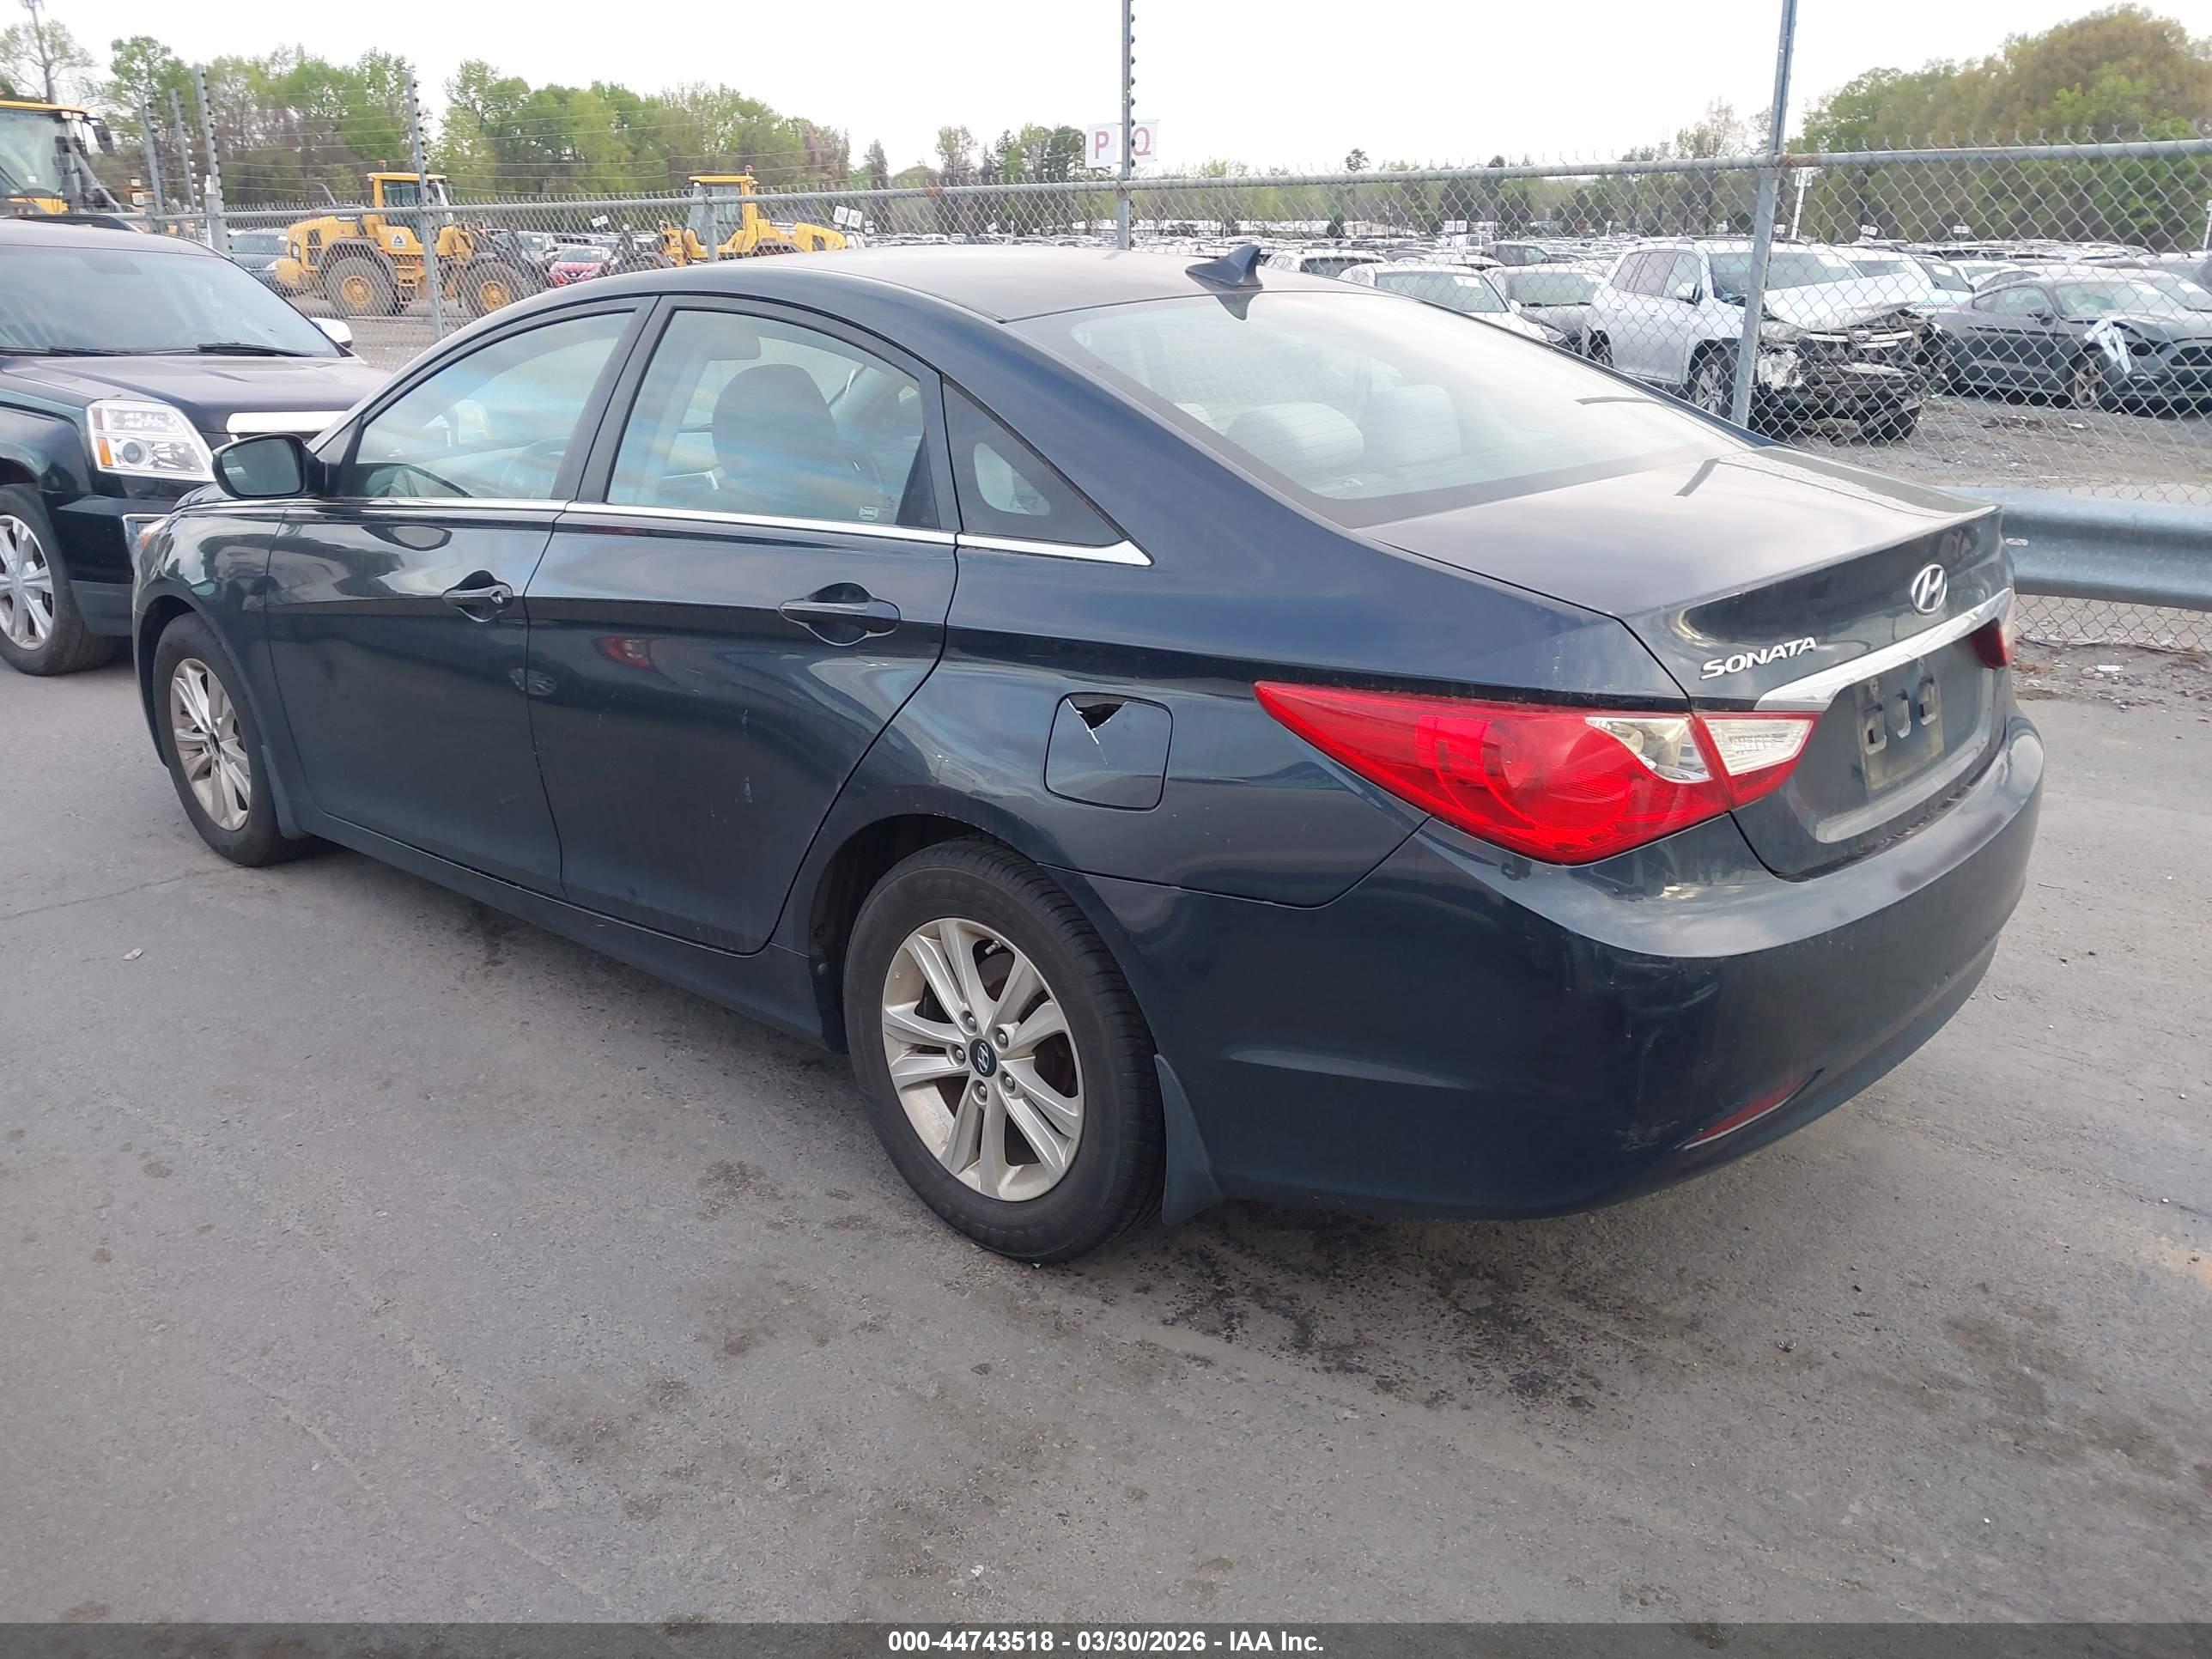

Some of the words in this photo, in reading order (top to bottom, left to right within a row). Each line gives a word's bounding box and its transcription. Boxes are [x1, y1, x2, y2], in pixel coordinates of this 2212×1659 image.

[1095, 131, 1109, 159] P
[1132, 127, 1151, 156] Q
[1700, 636, 1817, 679] SONATA
